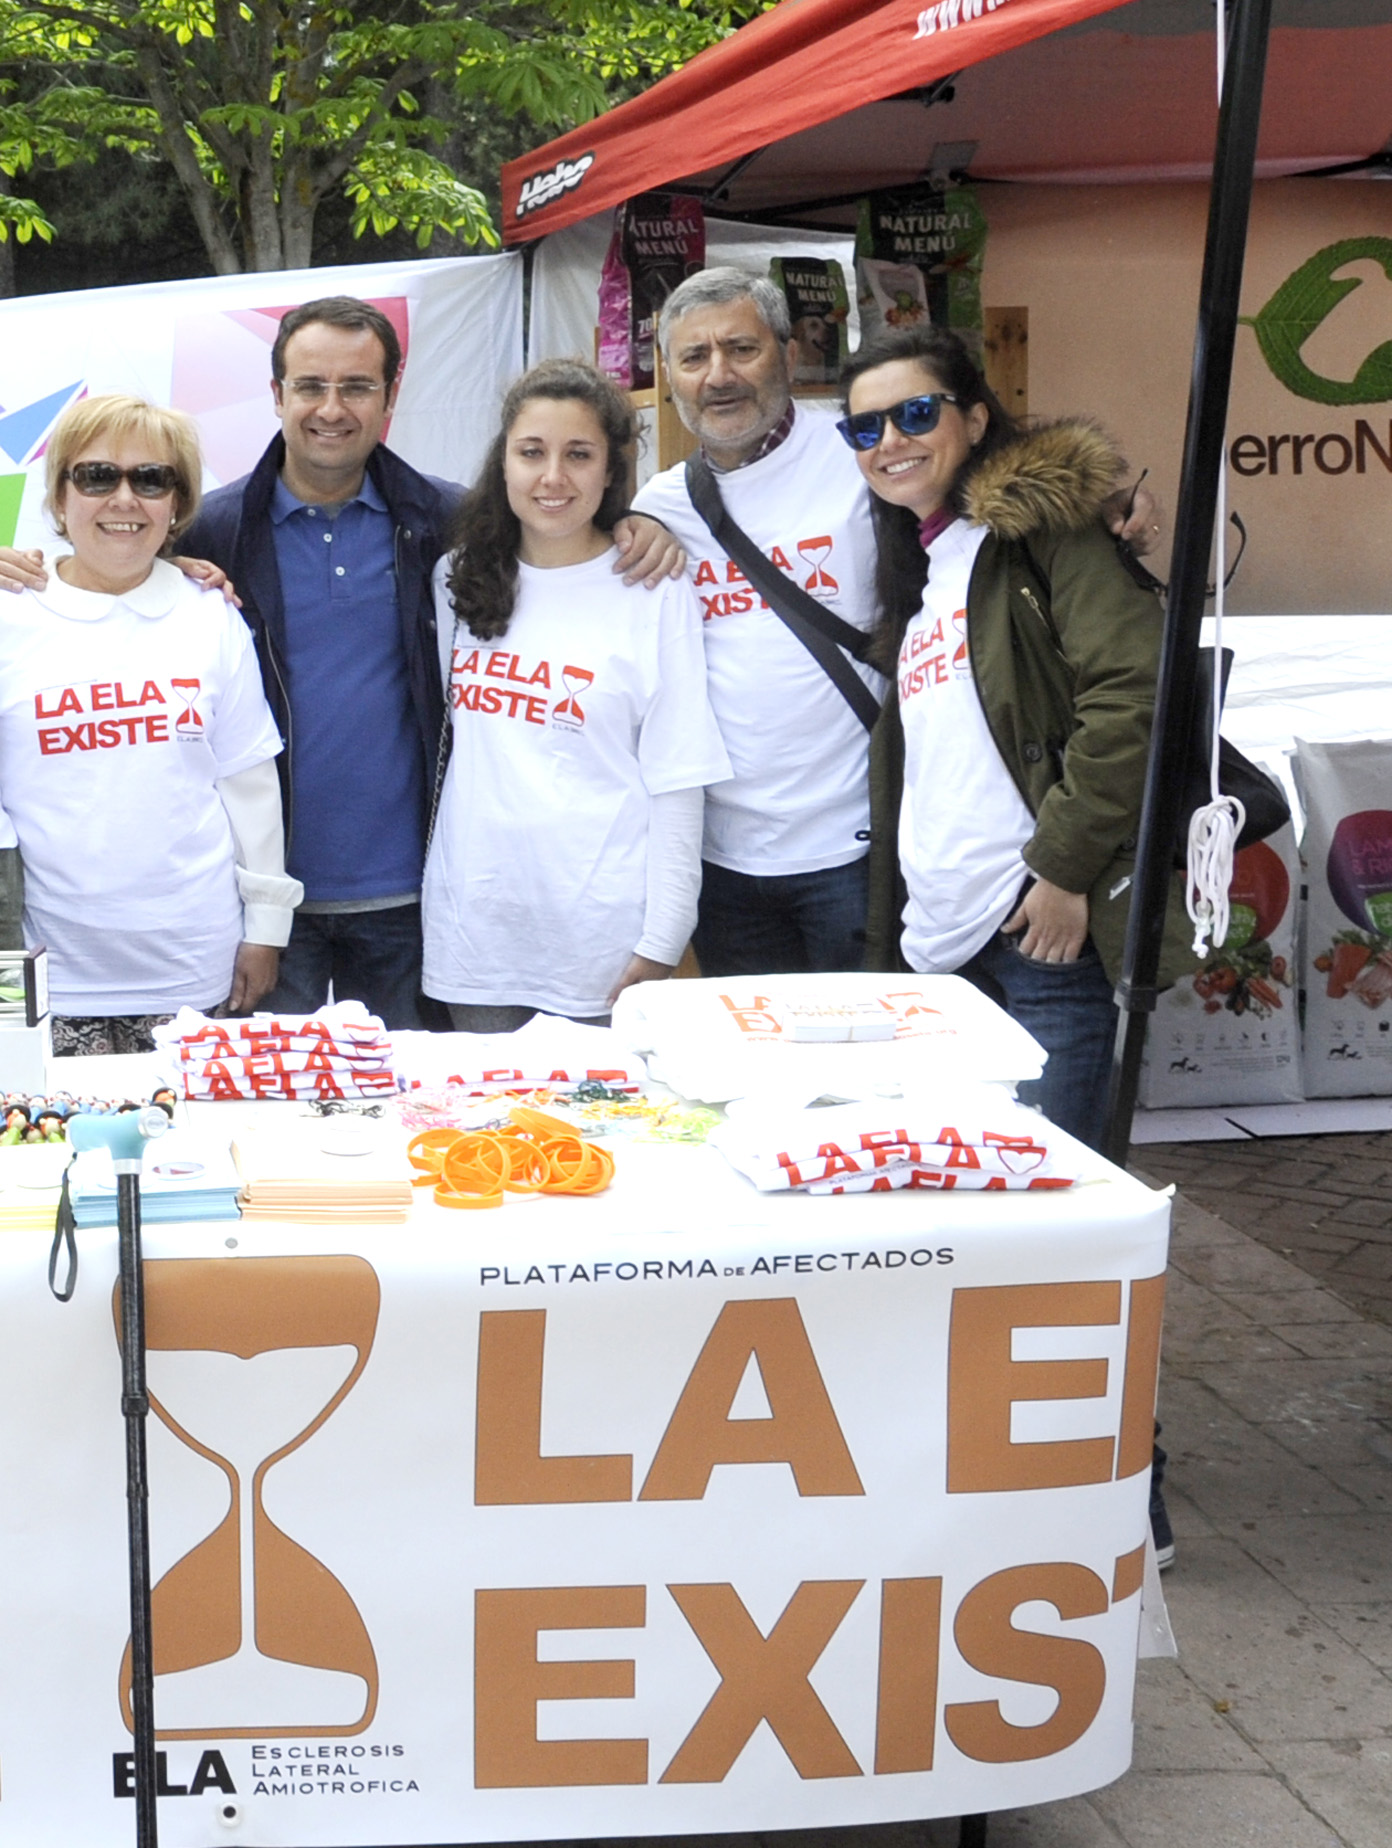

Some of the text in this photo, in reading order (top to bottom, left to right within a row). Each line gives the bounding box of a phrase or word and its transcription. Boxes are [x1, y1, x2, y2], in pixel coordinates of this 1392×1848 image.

[629, 215, 699, 238] ATURAL
[879, 213, 972, 233] NATURAL
[1230, 418, 1392, 477] erroN
[484, 651, 551, 690] ELA
[34, 687, 85, 719] LA
[90, 680, 167, 711] ELA
[37, 714, 170, 756] EXISTE
[480, 1247, 955, 1286] PLATAFORMA DE AFECTADOS
[474, 1296, 867, 1506] LA
[474, 1537, 1147, 1789] EXIS
[251, 1743, 405, 1760] ESCLEROSIS
[251, 1763, 360, 1778] LATERAL
[253, 1779, 420, 1796] AMIOTROFICA
